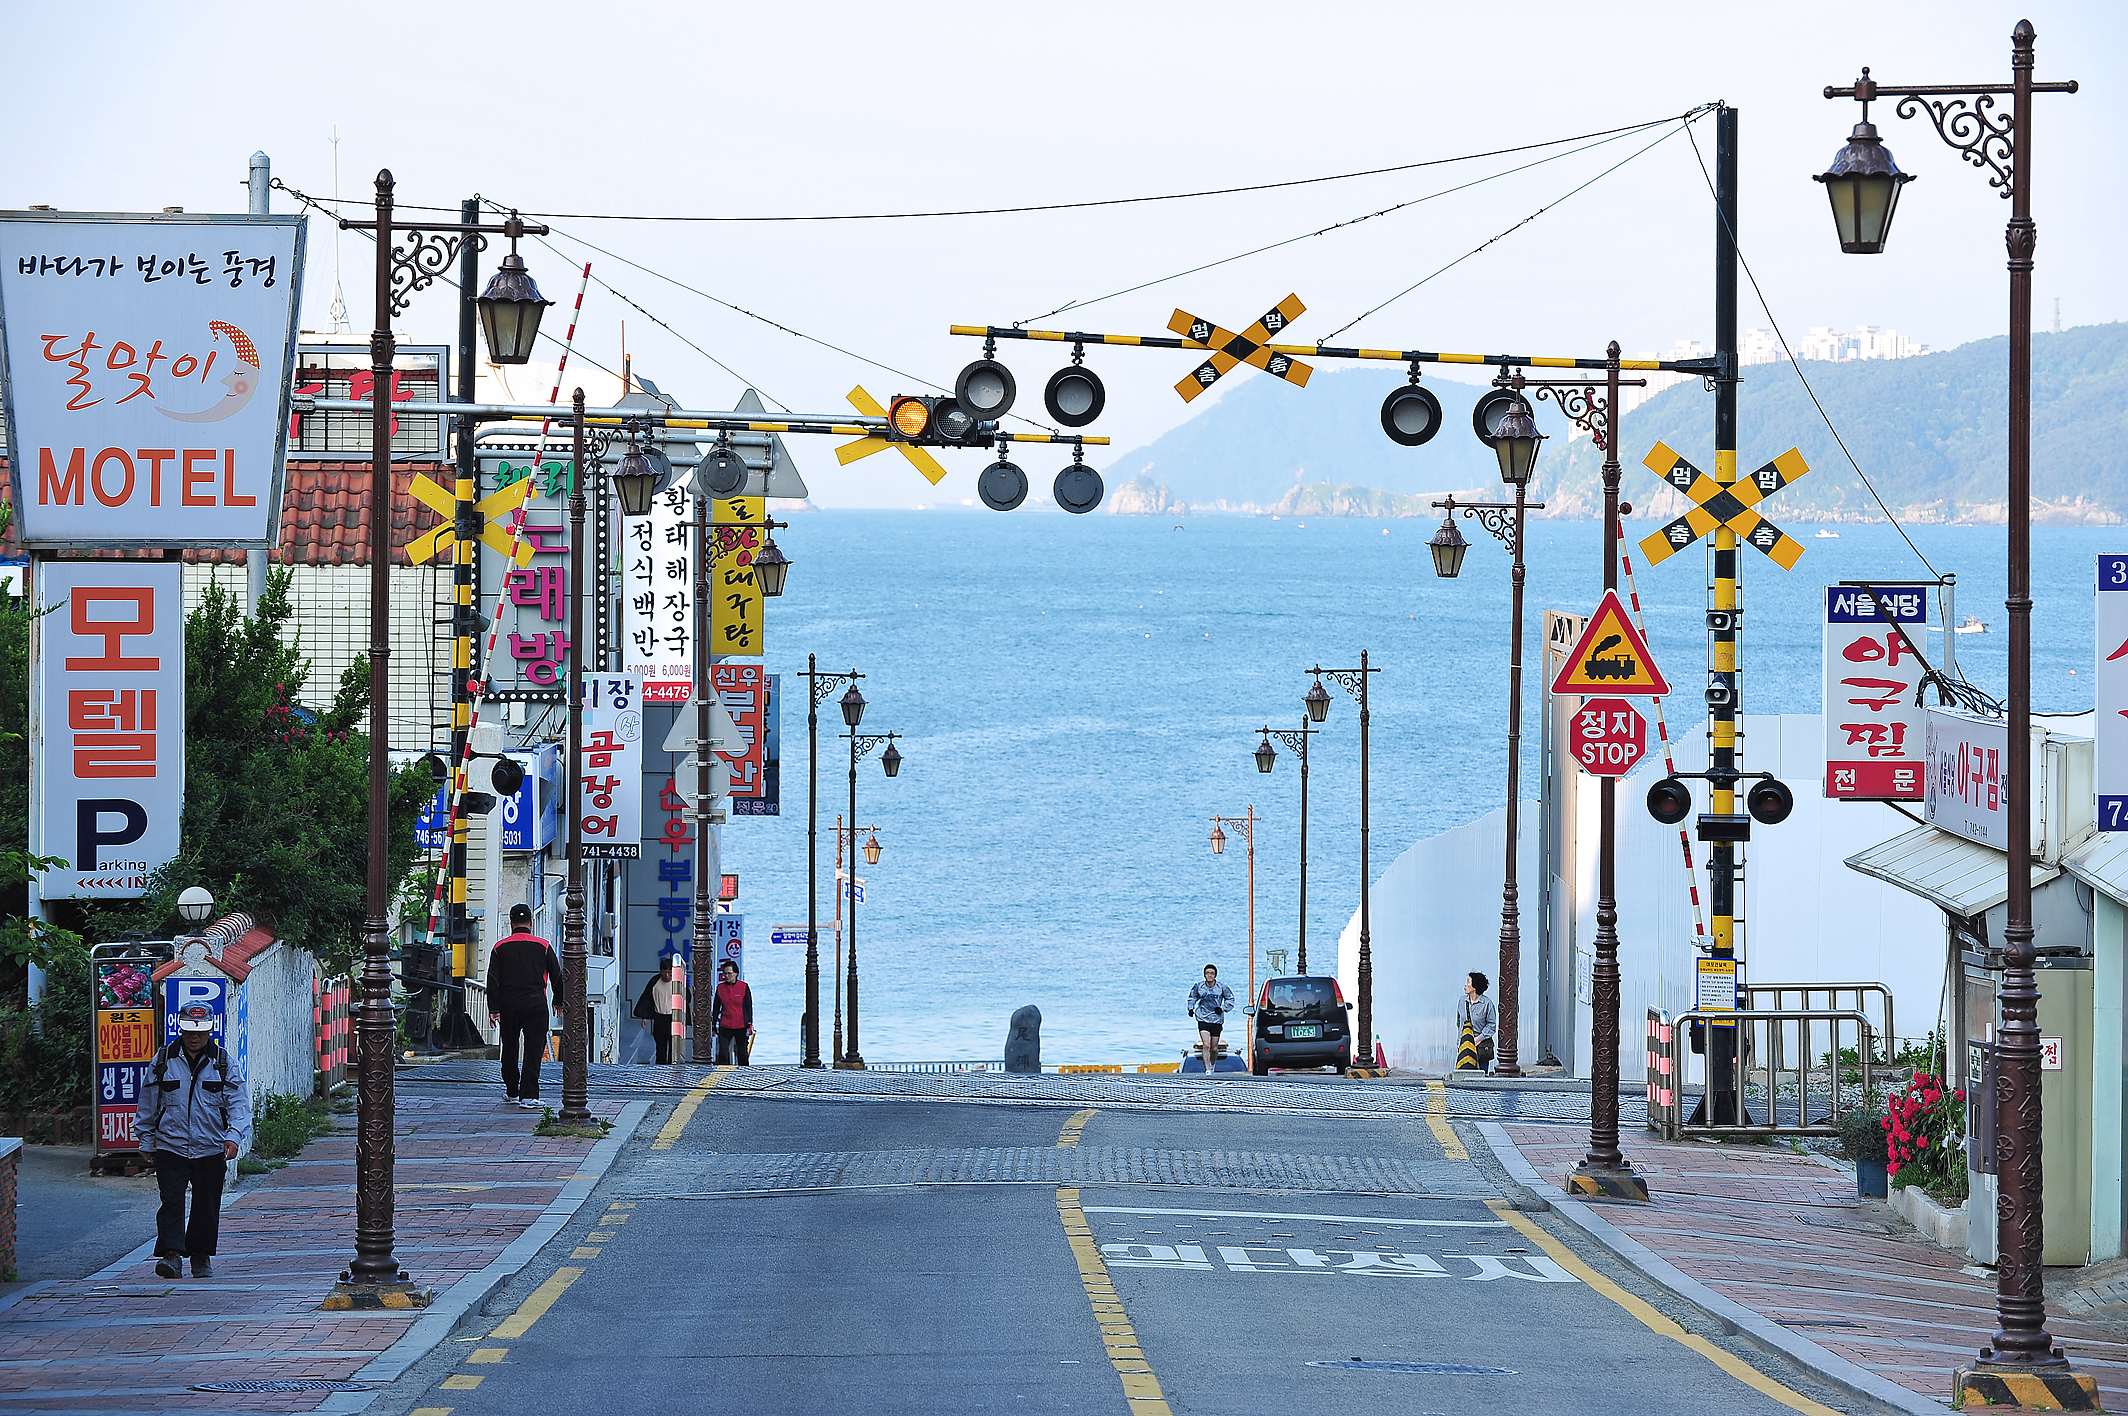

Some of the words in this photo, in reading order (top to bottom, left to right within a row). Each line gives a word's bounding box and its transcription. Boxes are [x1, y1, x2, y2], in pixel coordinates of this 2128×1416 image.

[18, 254, 124, 278] 바다가
[136, 252, 213, 285] 보이는
[221, 250, 277, 288] 풍경
[1191, 322, 1209, 339] 멈
[1265, 313, 1282, 330] 멈
[40, 330, 218, 412] 달맞이
[1198, 366, 1216, 383] 춤
[1269, 356, 1288, 374] 춤
[37, 446, 258, 508] MOTEL
[1672, 466, 1691, 486] 멈
[1758, 470, 1778, 490] 멈
[1669, 524, 1691, 544] 춤
[1753, 526, 1776, 546] 춤
[630, 496, 659, 657] 정식백반
[663, 485, 691, 658] 황태해장국
[507, 507, 571, 685] 노래방
[65, 585, 161, 780] 모텔
[661, 663, 692, 678] 6,000원
[715, 667, 760, 688] 신우
[642, 684, 691, 699] 4-4475
[1840, 631, 1914, 758] 아구찜
[1580, 709, 1636, 740] 정지
[1581, 742, 1638, 766] STOP
[581, 730, 626, 838] 곰장어
[1957, 740, 2000, 812] 아구찜
[581, 845, 638, 858] 741-4438
[109, 1011, 142, 1024] 원조
[99, 1022, 154, 1061] 언양불고기
[1100, 1242, 1582, 1284] 일단정지
